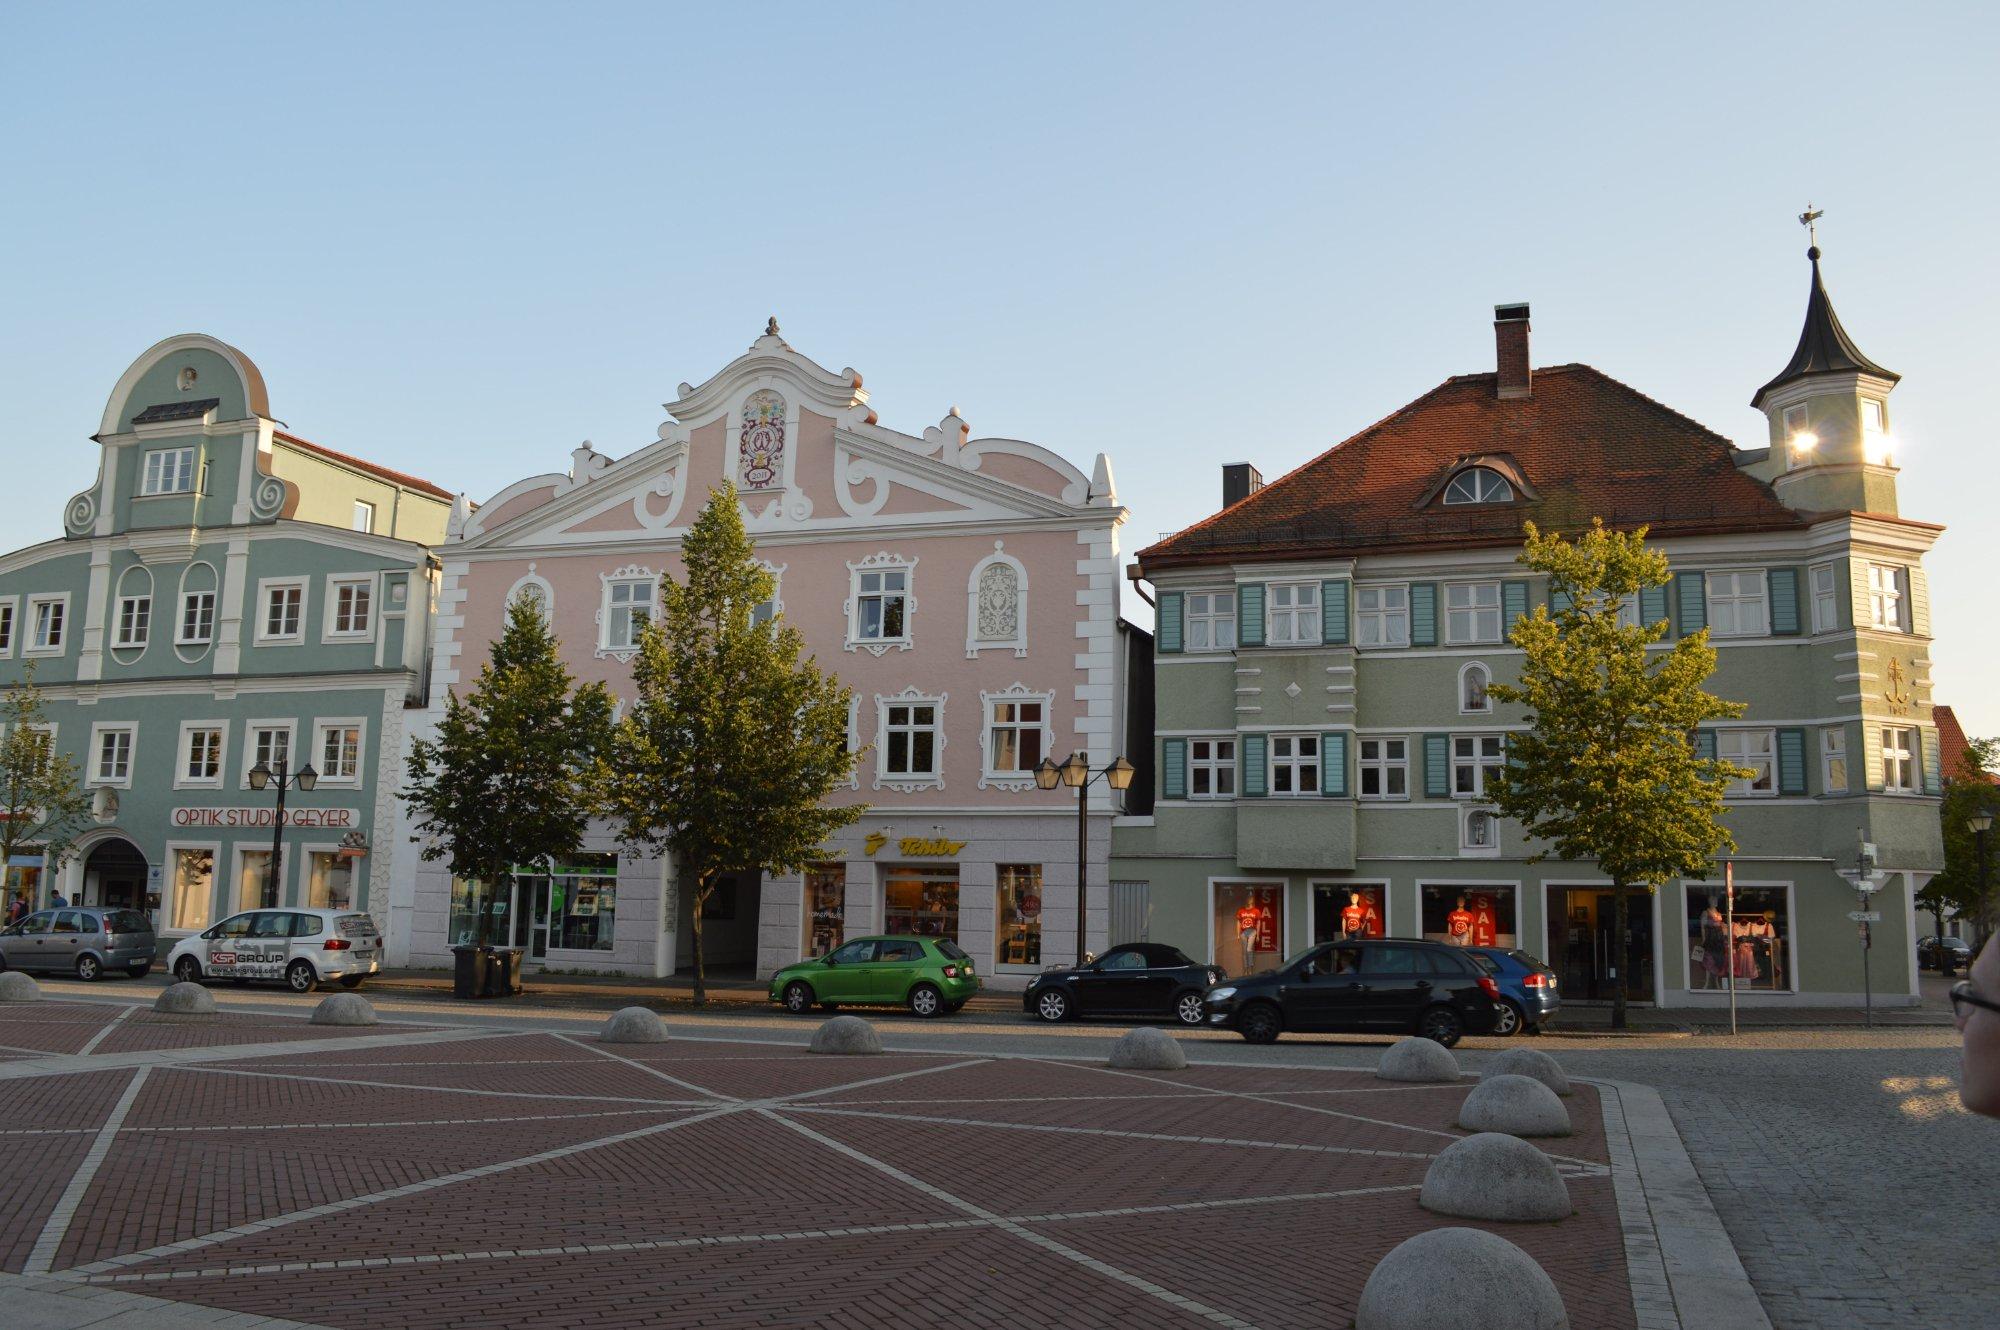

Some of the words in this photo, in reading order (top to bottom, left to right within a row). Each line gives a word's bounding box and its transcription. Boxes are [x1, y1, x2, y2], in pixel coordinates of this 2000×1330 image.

[176, 809, 223, 825] OPTIK
[293, 809, 350, 826] GEYER
[898, 837, 968, 856] Tchibo
[1261, 889, 1272, 948] SALE
[1365, 890, 1377, 935] SAL
[211, 952, 236, 964] KSR
[237, 954, 284, 963] GROUP
